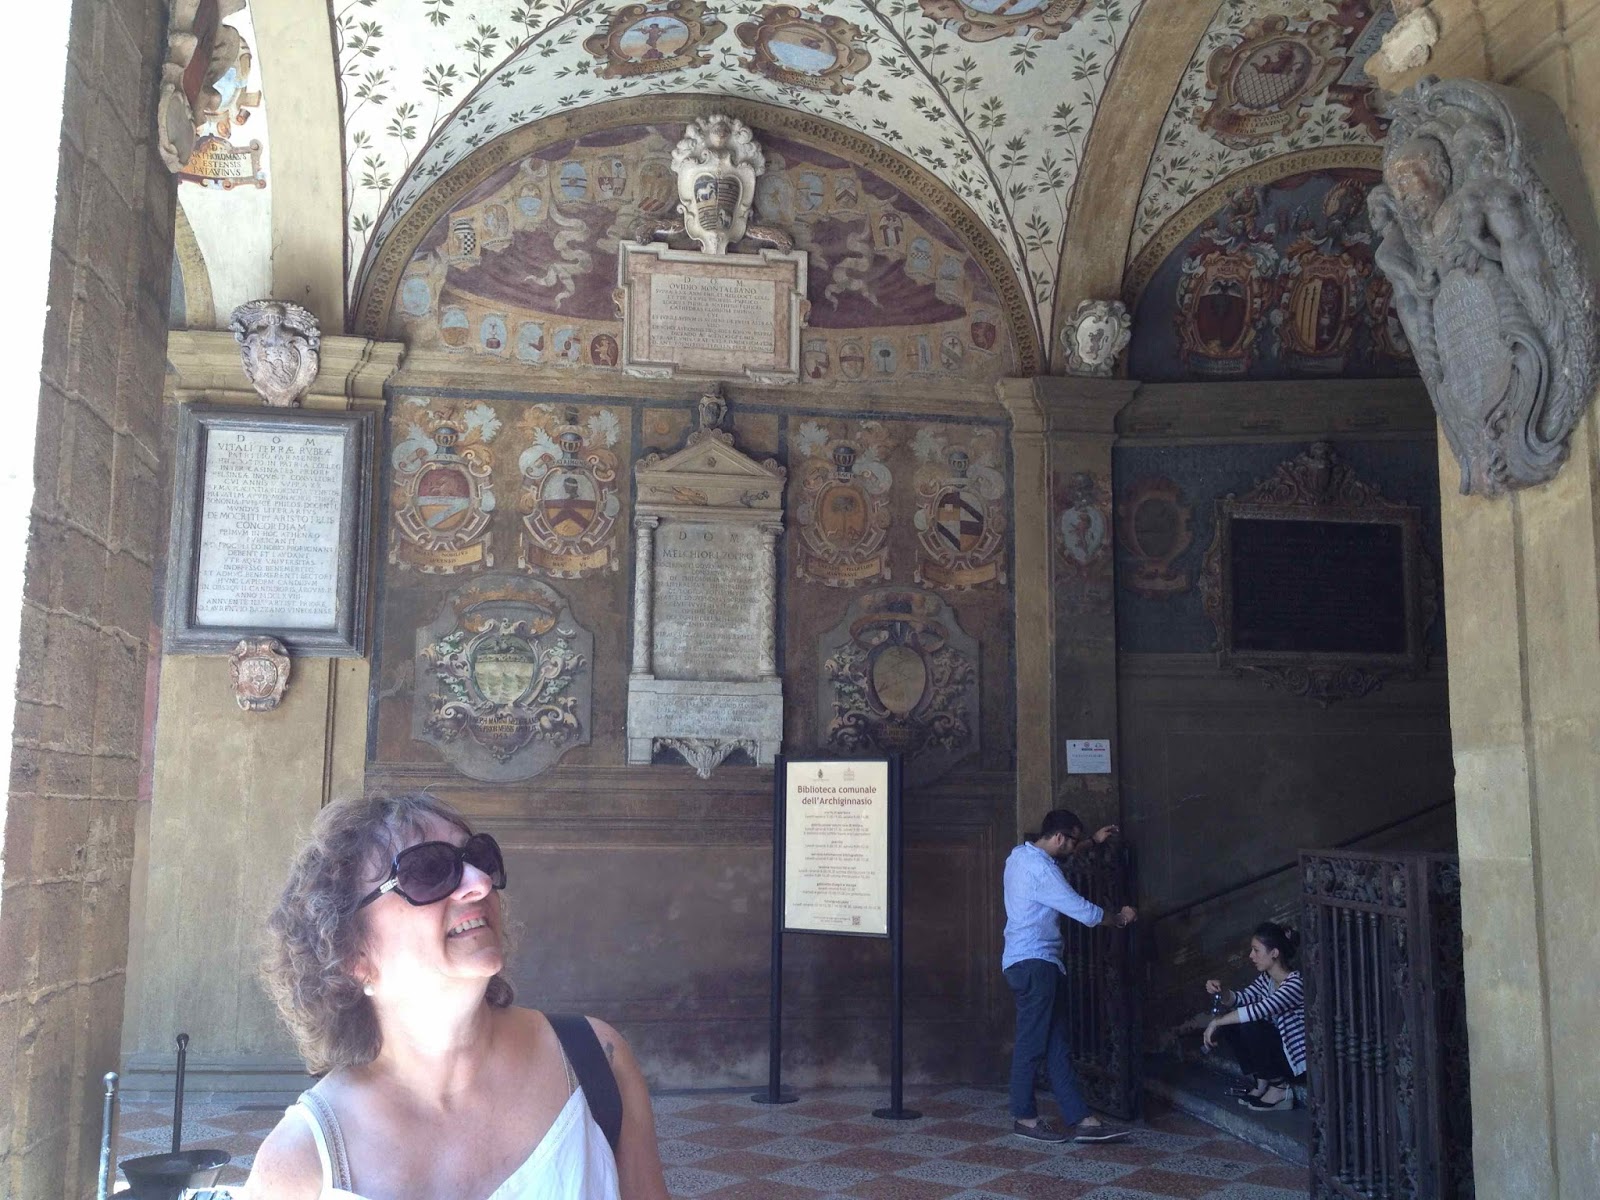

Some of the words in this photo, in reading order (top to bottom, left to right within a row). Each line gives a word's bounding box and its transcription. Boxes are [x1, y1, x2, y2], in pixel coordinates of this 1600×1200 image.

[701, 285, 757, 294] MONTALBANO
[237, 434, 245, 442] D
[272, 436, 281, 444] O
[305, 438, 315, 446] M
[218, 443, 253, 452] VITALI
[236, 521, 306, 531] CONCORDIAM
[679, 531, 687, 541] D
[704, 531, 713, 542] O
[730, 534, 739, 543] M
[662, 549, 719, 559] MELCHIORI
[797, 785, 836, 793] Biblioteca
[838, 785, 877, 793] comunale
[802, 797, 872, 807] dell'Archiginnasio
